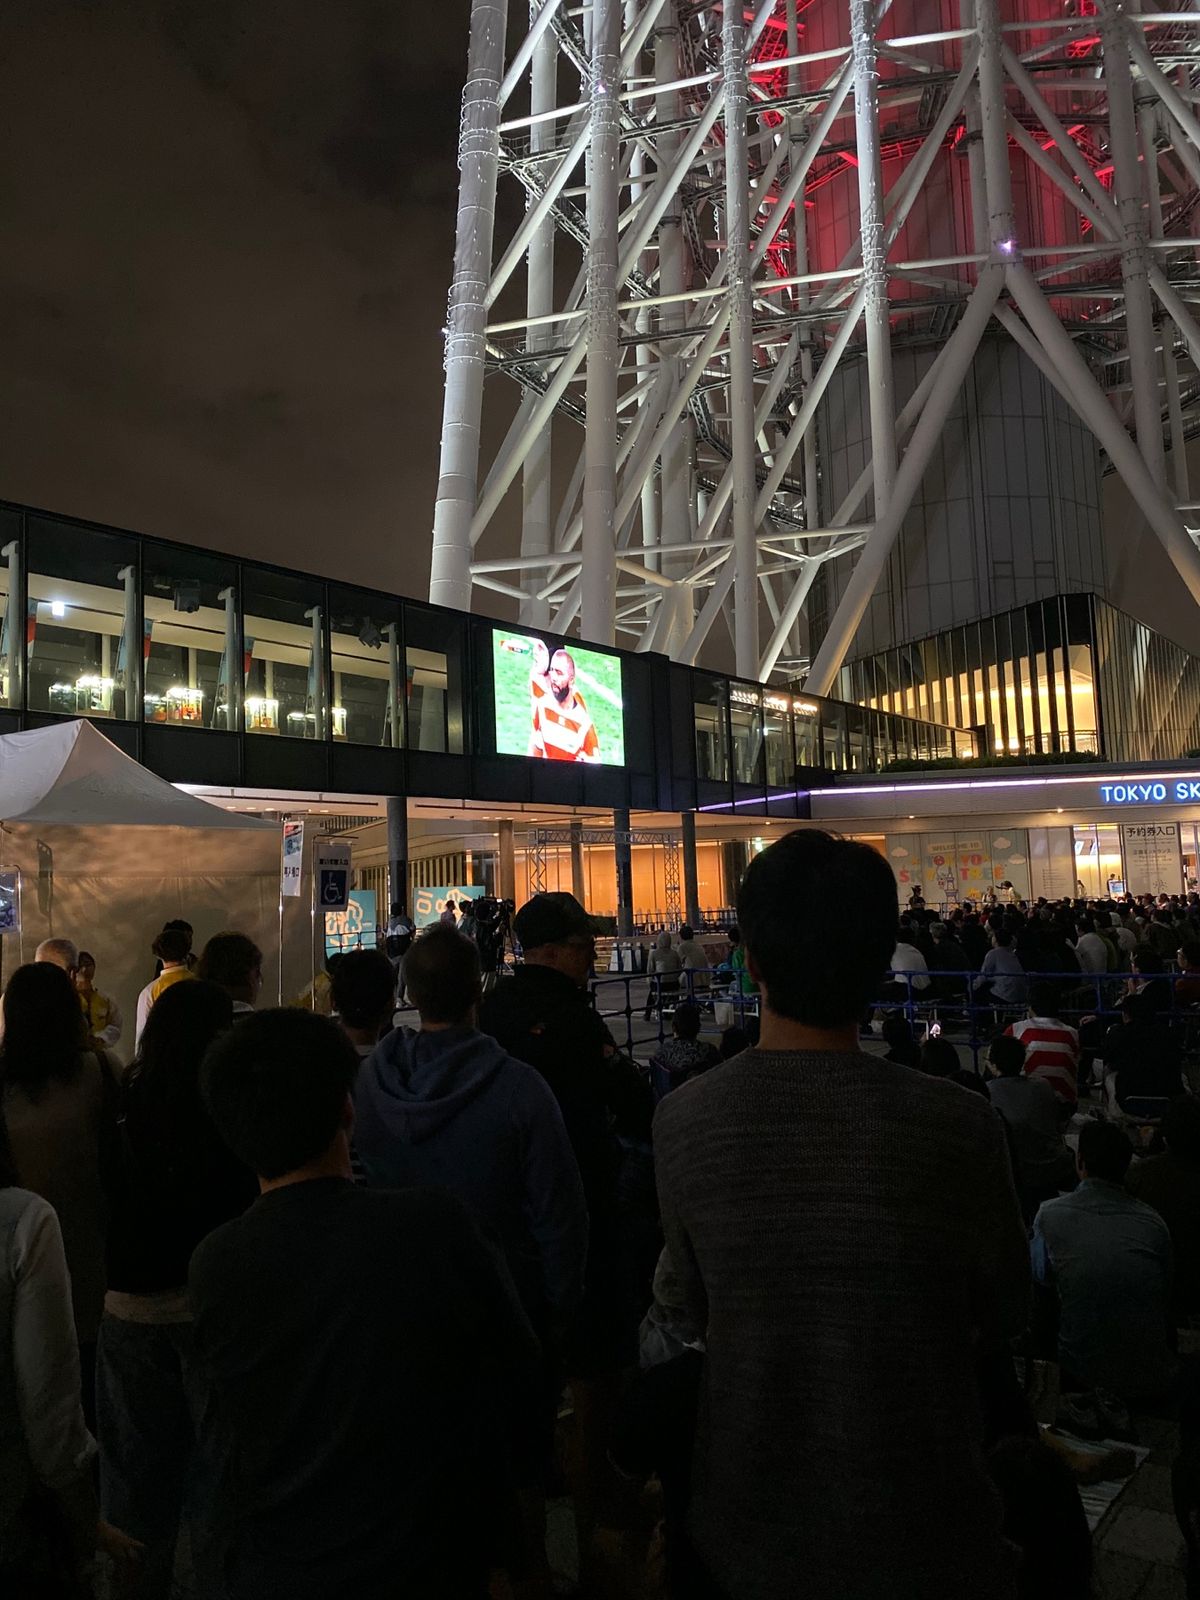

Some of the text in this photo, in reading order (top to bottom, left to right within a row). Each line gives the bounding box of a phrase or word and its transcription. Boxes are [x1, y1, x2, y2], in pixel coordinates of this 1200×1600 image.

[1101, 783, 1166, 802] TOKYO
[1126, 826, 1175, 838] 予約券入口
